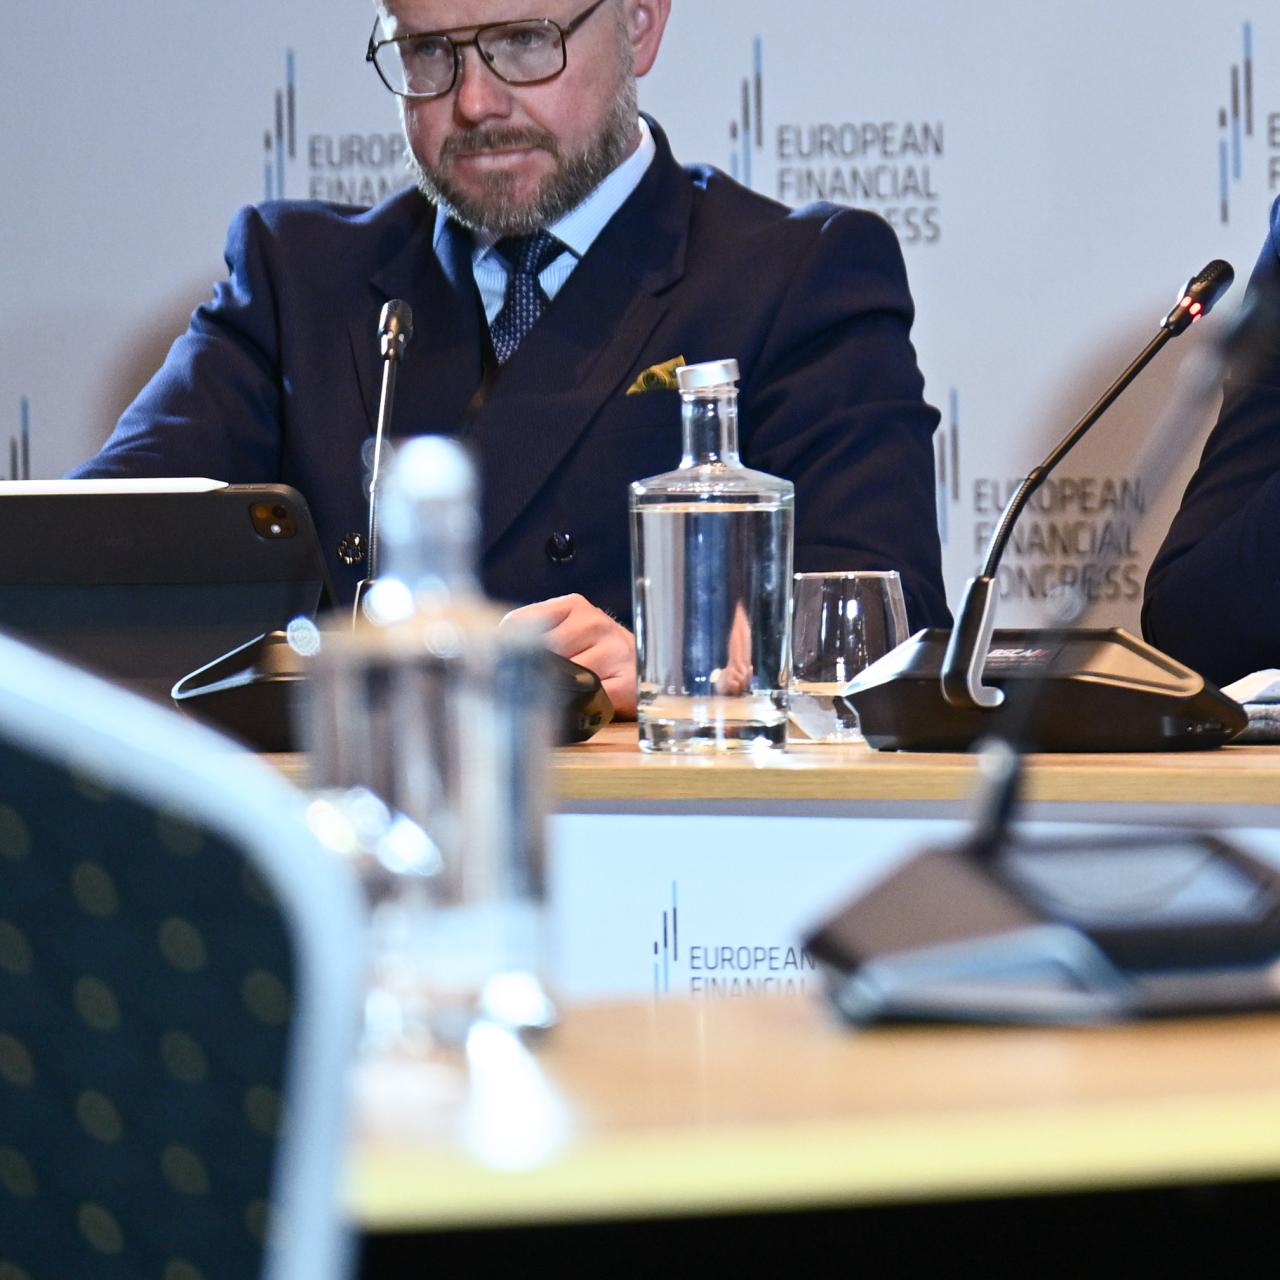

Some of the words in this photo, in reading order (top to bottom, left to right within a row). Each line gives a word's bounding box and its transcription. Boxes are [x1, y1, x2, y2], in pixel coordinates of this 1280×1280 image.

[308, 132, 406, 170] EUROP
[775, 120, 945, 163] EUROPEAN
[776, 166, 940, 202] FINANCIAL
[974, 521, 1139, 557] FNANCIAL
[689, 945, 816, 971] EUROPEAN
